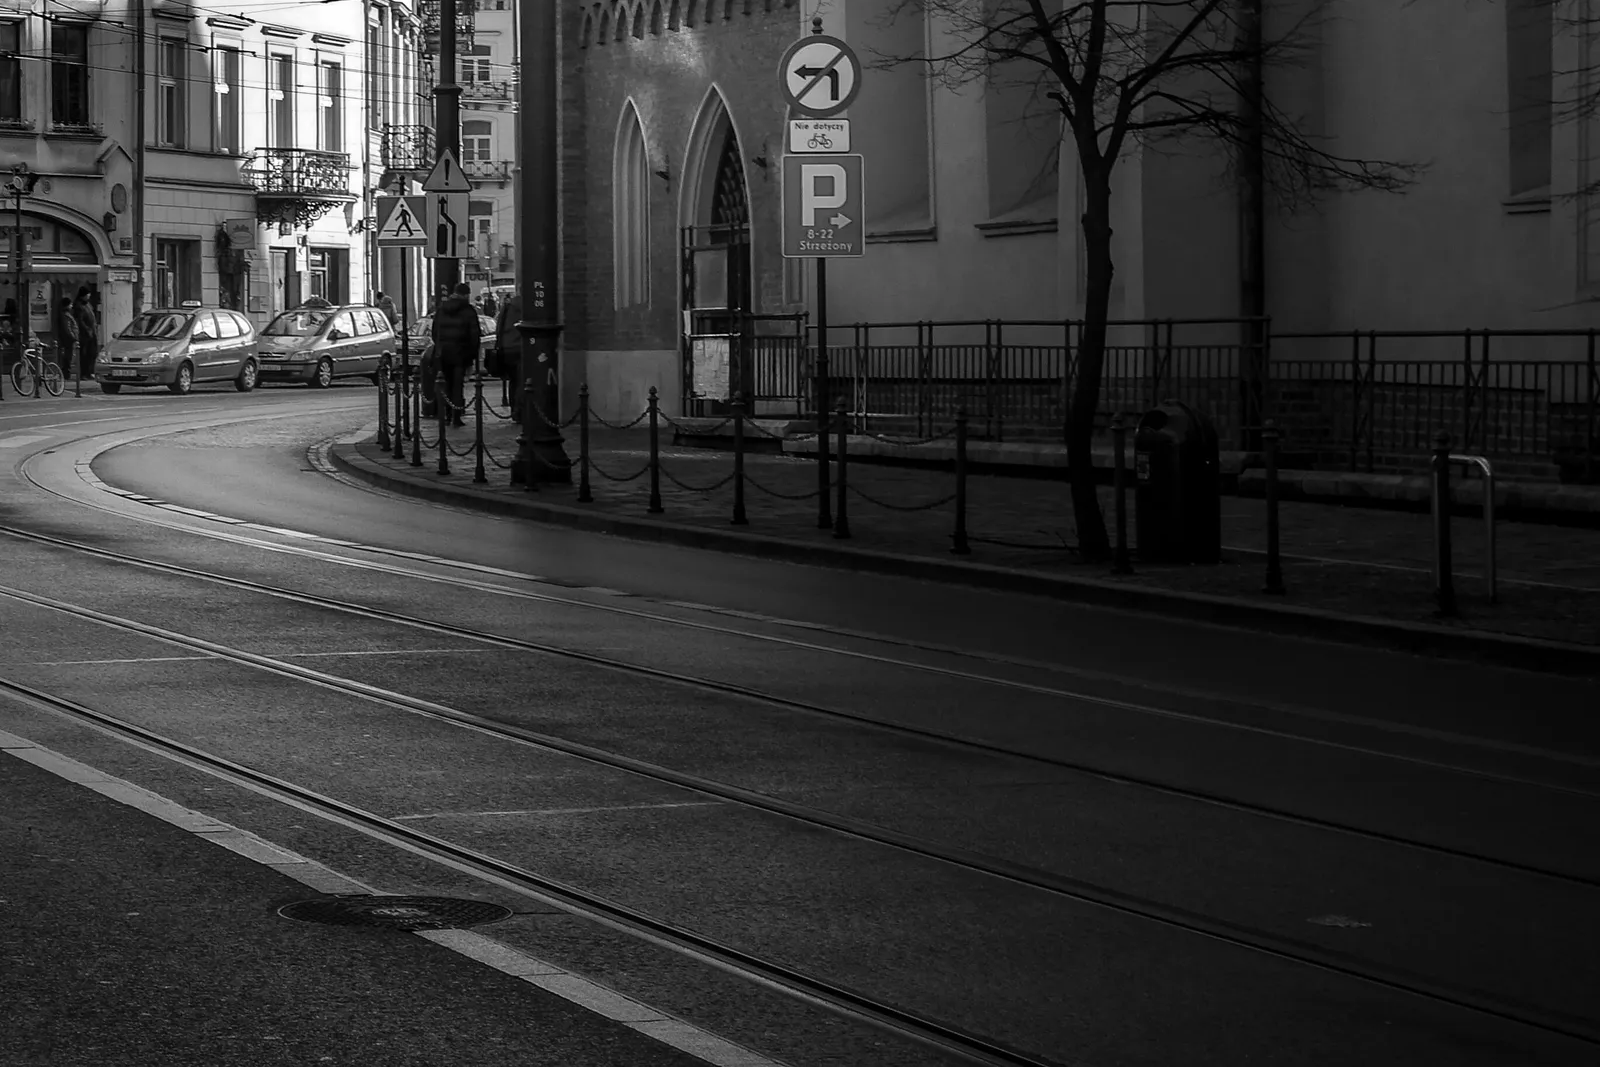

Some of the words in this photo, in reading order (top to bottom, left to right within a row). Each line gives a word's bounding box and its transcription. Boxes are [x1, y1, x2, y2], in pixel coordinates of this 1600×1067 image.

[795, 122, 809, 131] Nie
[813, 122, 844, 133] dotyczy
[801, 164, 847, 226] P
[807, 229, 833, 239] 8-22
[800, 241, 853, 252] Strzeżony
